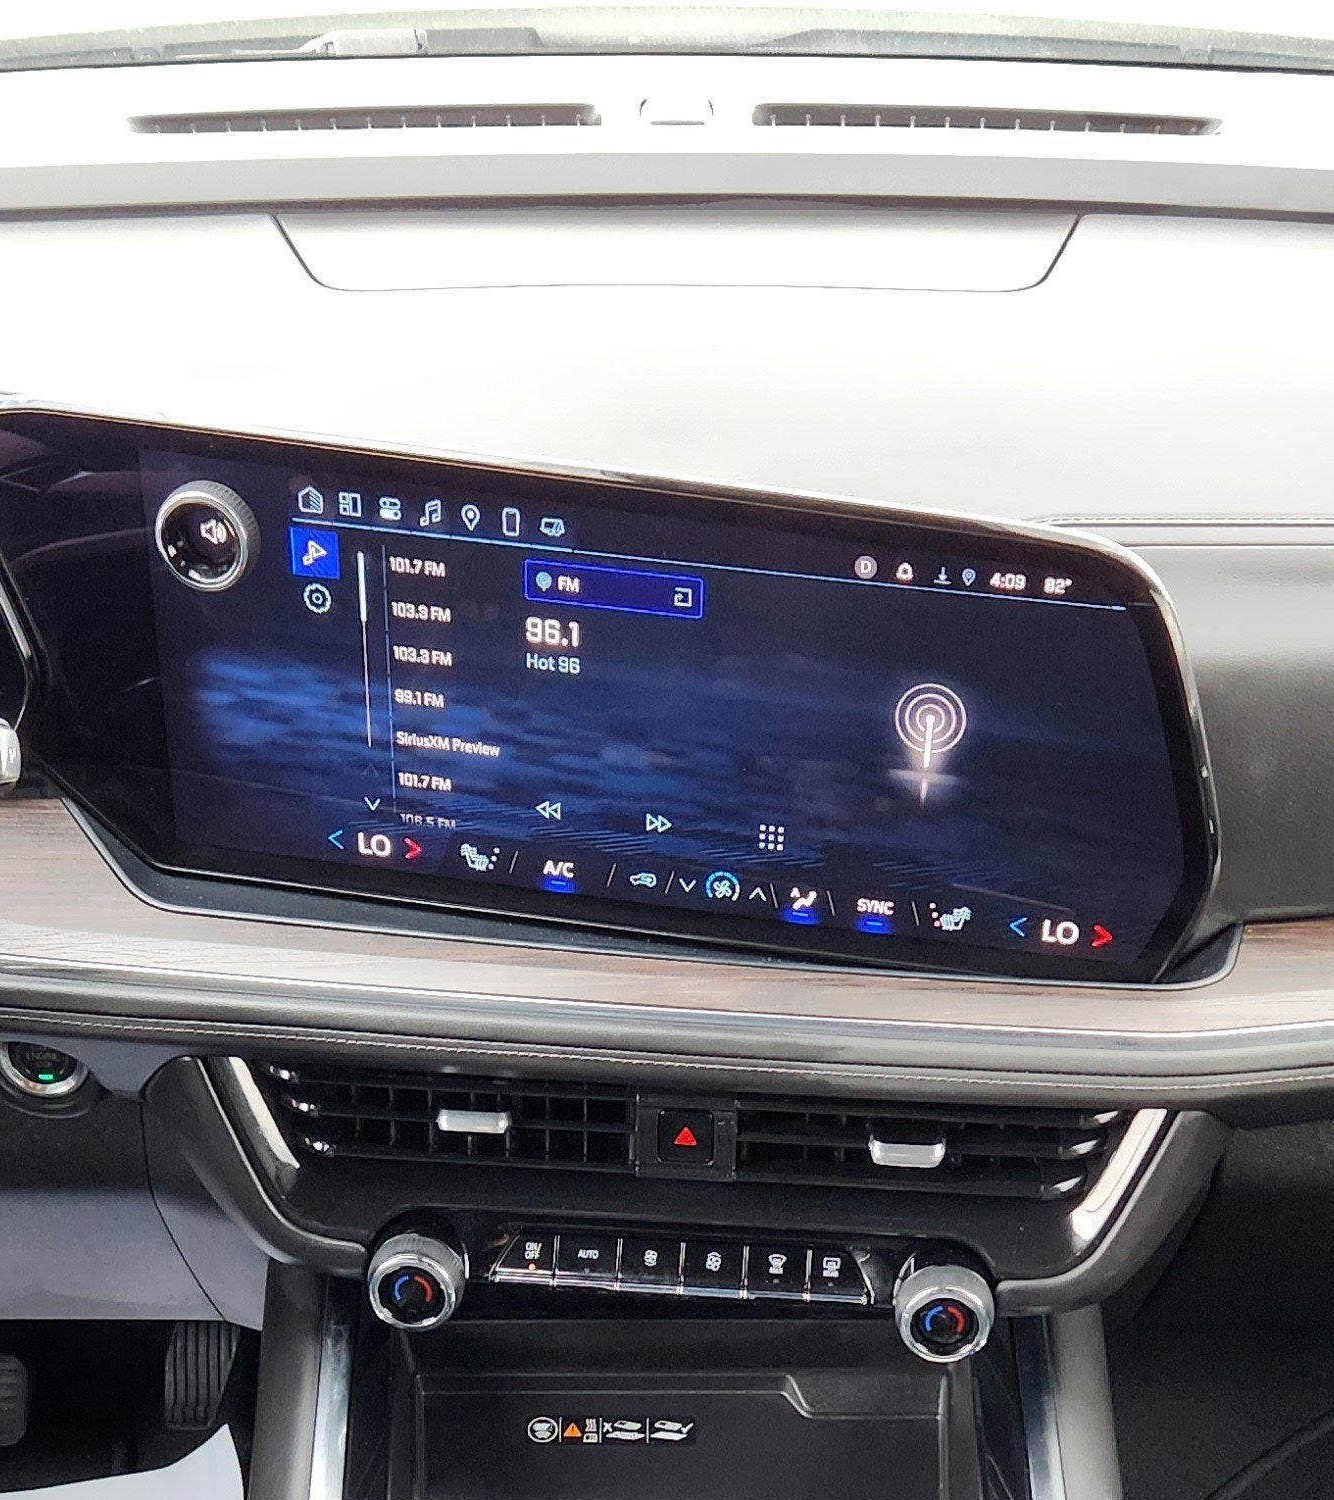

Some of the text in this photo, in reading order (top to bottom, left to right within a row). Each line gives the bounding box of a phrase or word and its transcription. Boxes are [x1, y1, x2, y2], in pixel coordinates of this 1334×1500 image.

[389, 556, 446, 578] 101.7 FM
[557, 576, 580, 594] FM
[989, 572, 1027, 592] 4:09
[430, 606, 451, 624] FM
[525, 616, 581, 648] 96.1
[431, 650, 452, 667] FM
[525, 653, 581, 675] Hot 96
[394, 688, 445, 709] 99.1 FM
[396, 731, 500, 757] SiriusXM Preview
[398, 772, 452, 792] 101.7 FM
[400, 812, 435, 828] 1065
[357, 832, 391, 858] LO
[543, 859, 575, 879] A/C
[856, 898, 896, 917] SYNC
[1042, 918, 1080, 946] LO
[577, 1249, 599, 1259] AUTO
